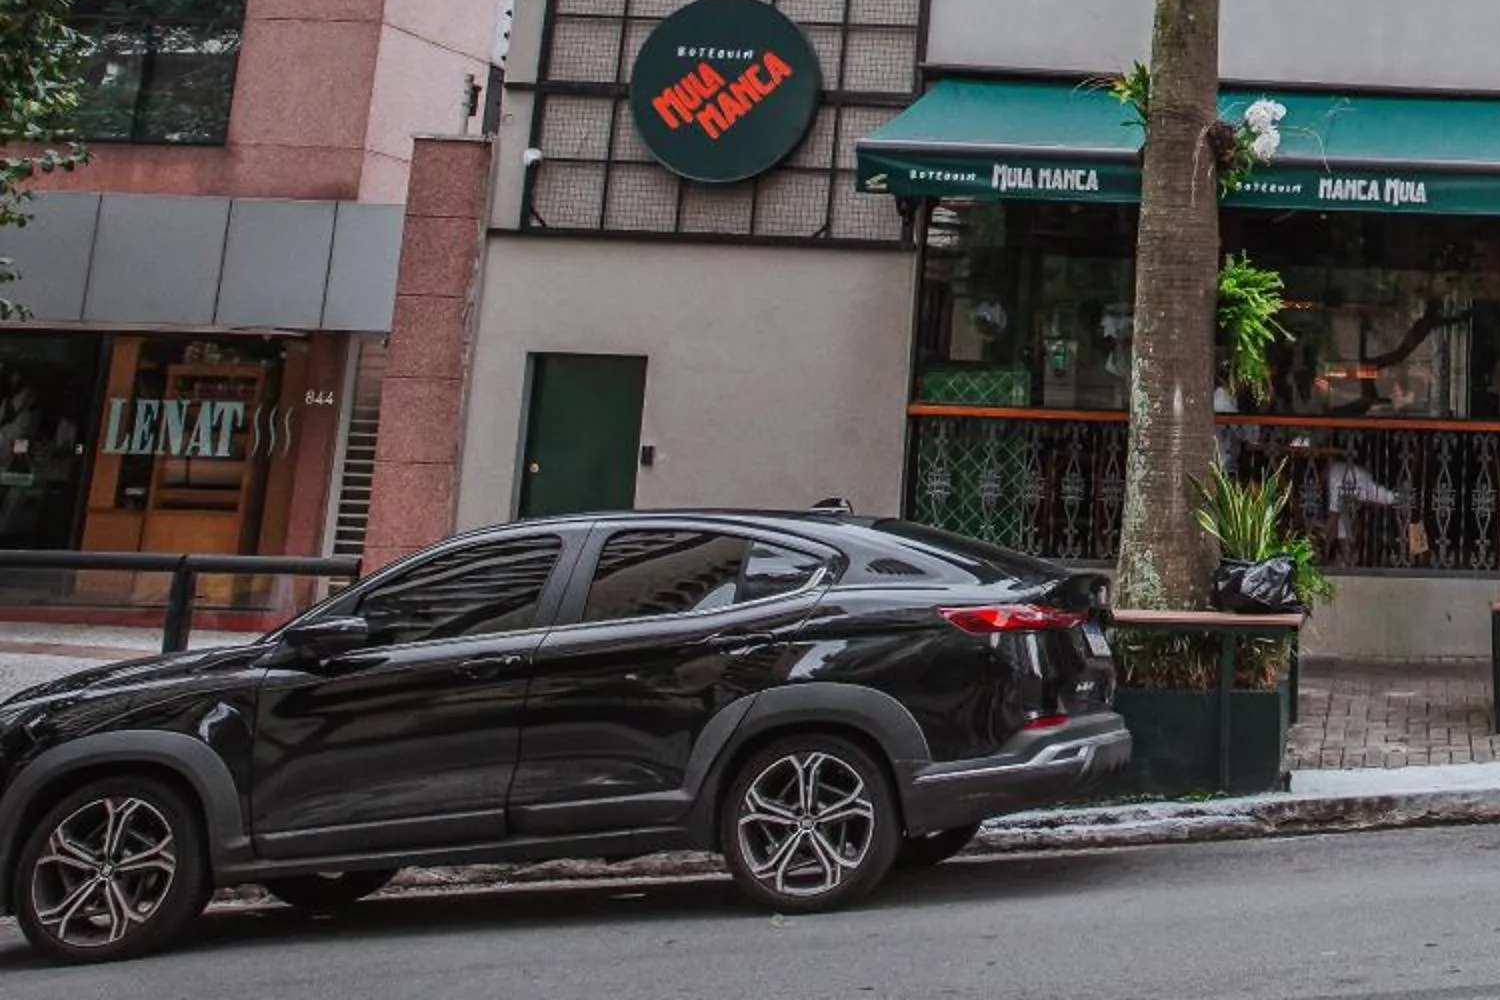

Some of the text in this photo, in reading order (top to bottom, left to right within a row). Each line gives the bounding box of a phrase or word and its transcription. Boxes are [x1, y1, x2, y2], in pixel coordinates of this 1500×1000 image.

[652, 62, 727, 129] MULA
[696, 51, 793, 140] MANCA
[1038, 168, 1099, 191] MANCA
[1318, 178, 1380, 201] MANCA
[305, 389, 335, 406] 844
